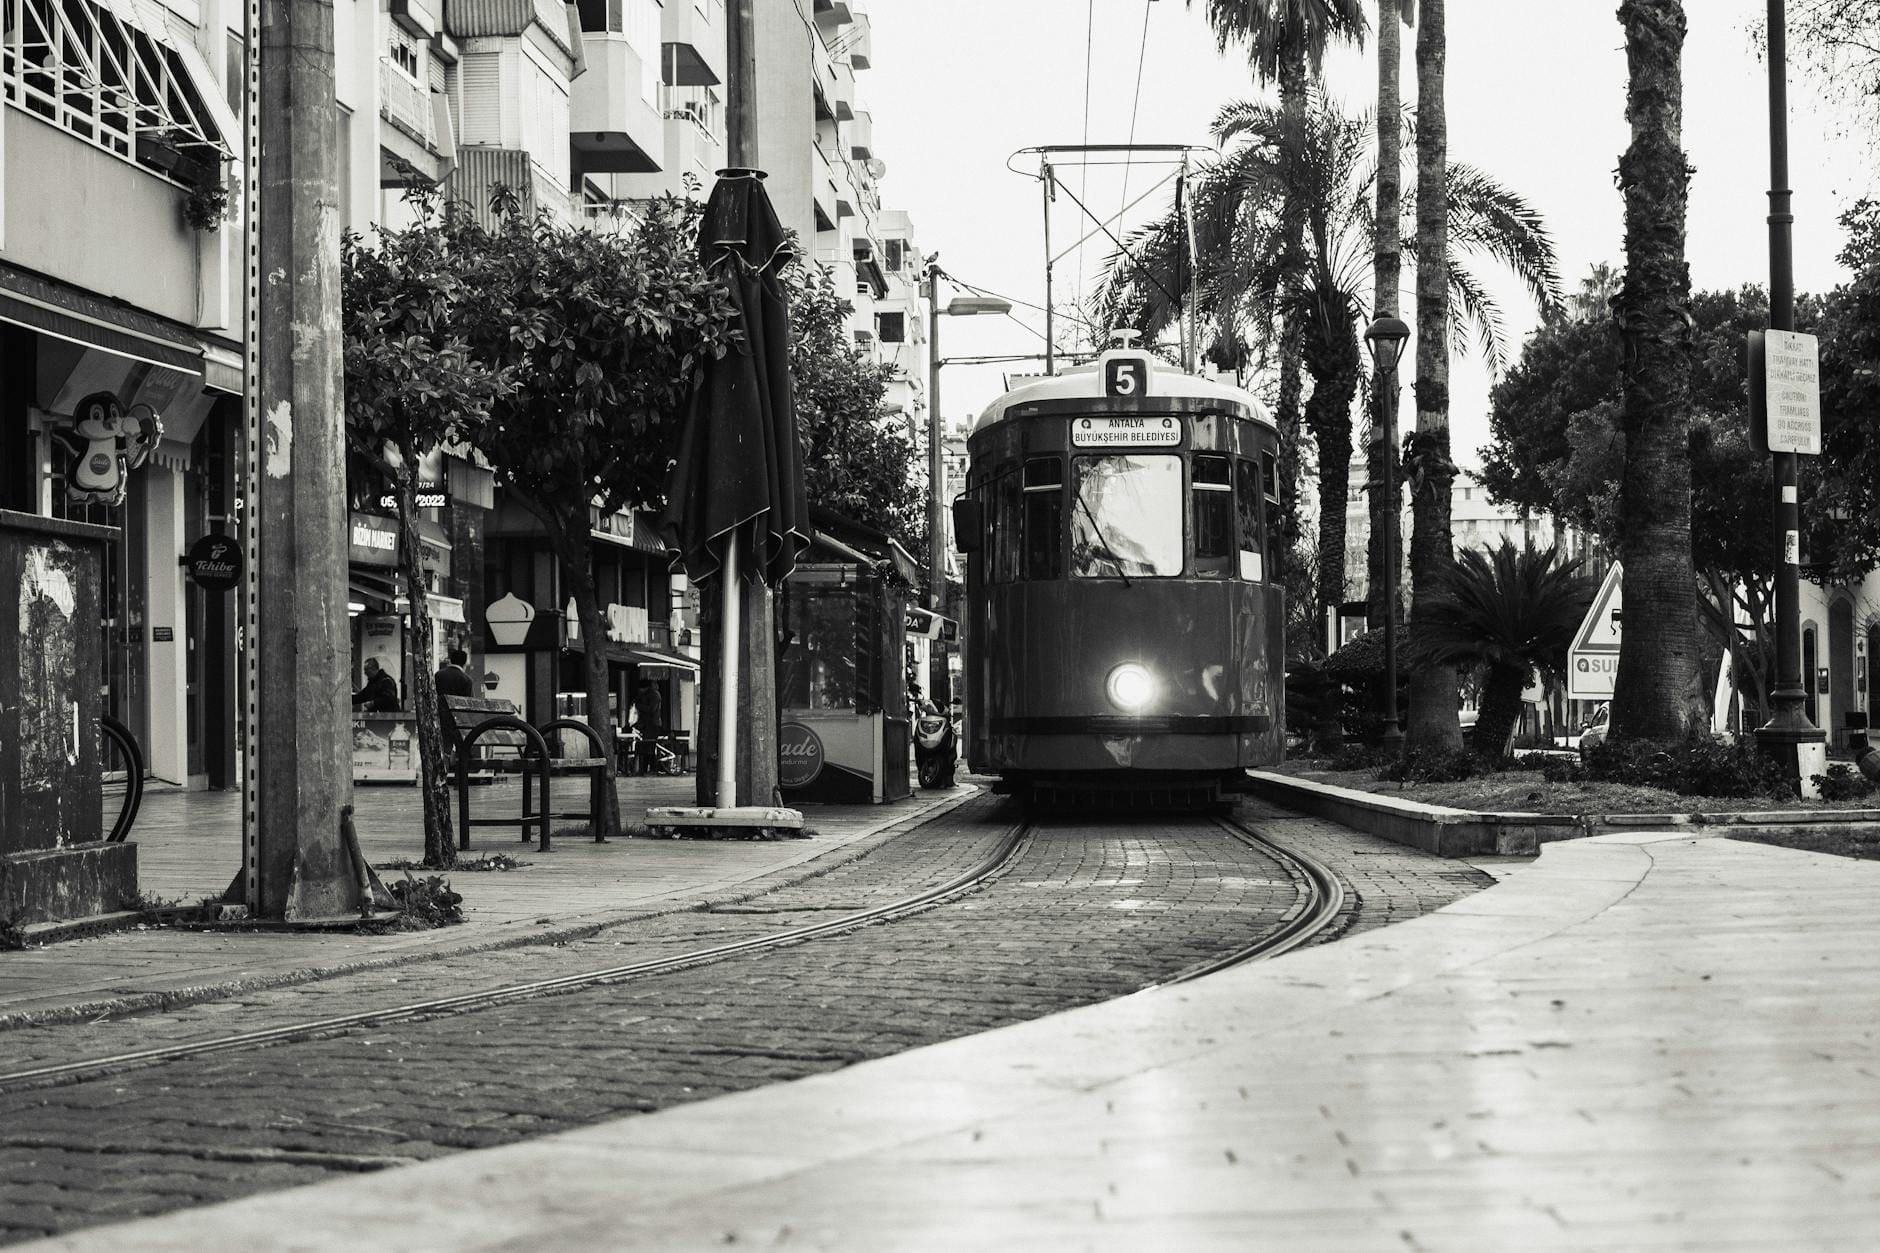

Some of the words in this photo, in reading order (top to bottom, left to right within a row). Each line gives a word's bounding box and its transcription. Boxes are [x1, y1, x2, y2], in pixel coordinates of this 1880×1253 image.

[1115, 365, 1136, 395] 5
[1108, 418, 1145, 429] ANTALYA
[371, 529, 396, 551] MARKET
[195, 560, 236, 571] Tchibo
[781, 735, 818, 757] ade
